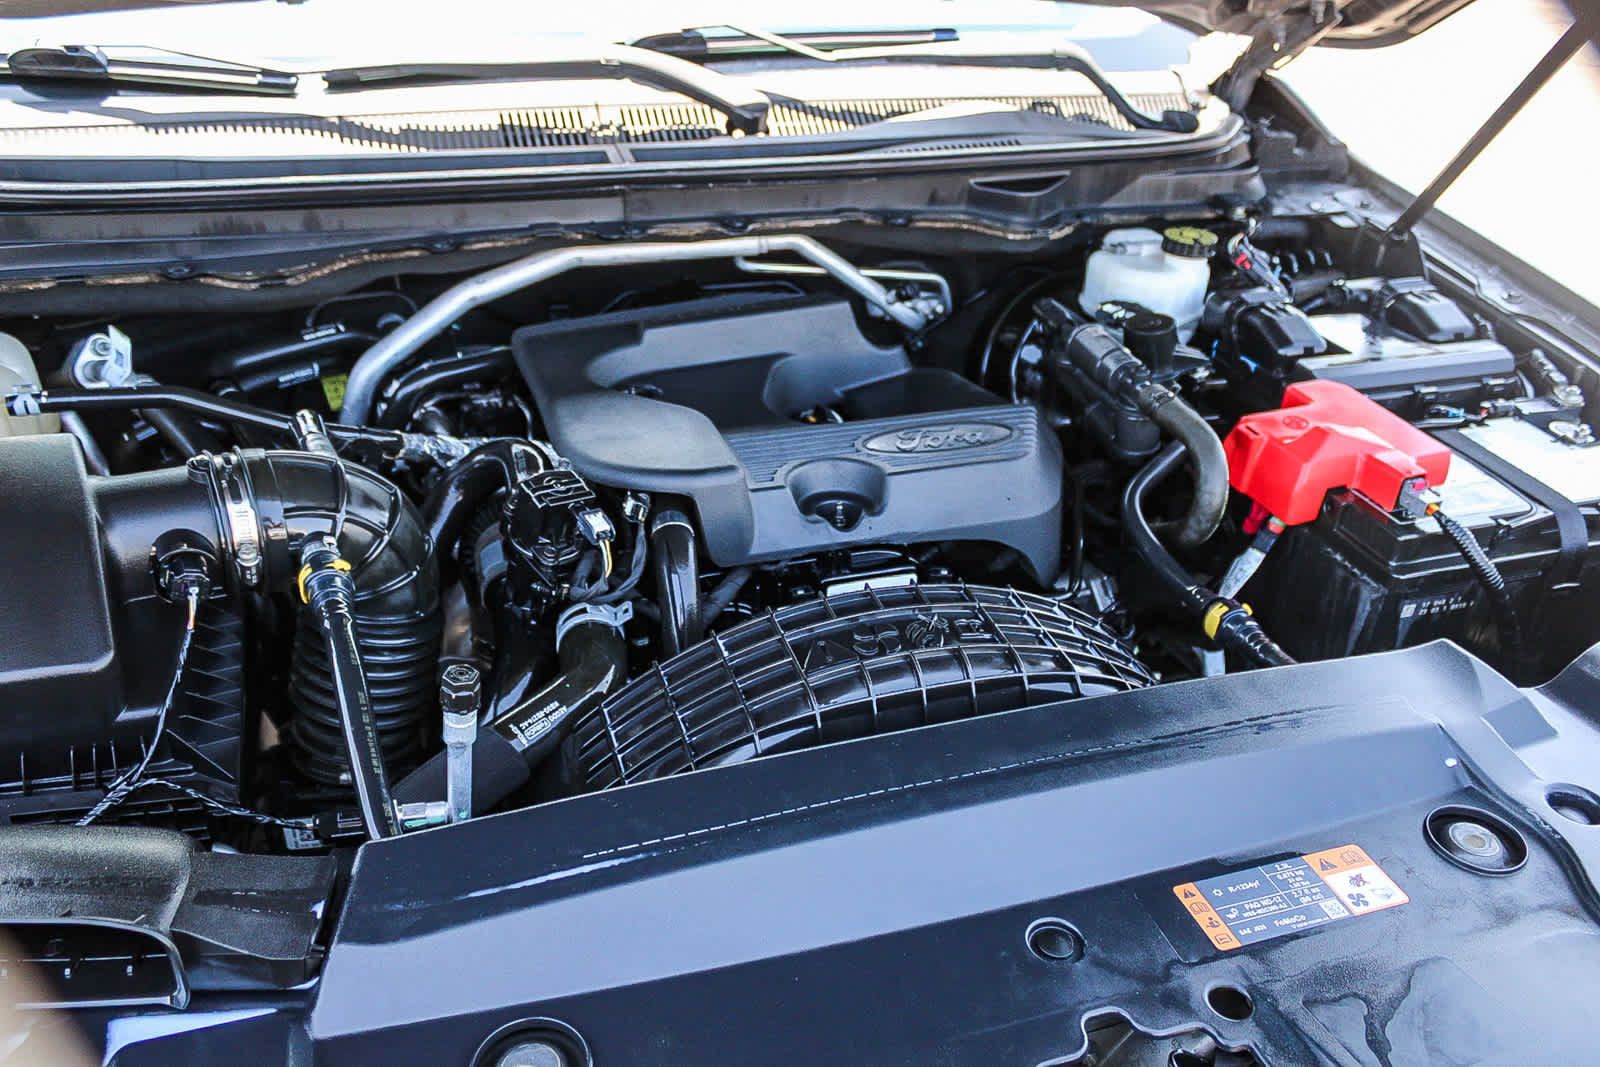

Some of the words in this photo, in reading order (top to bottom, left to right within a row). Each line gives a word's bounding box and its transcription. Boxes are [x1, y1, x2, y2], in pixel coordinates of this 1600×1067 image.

[896, 426, 984, 451] Ford
[1228, 880, 1261, 893] R-1234yf
[1273, 914, 1307, 927] FoMoCo
